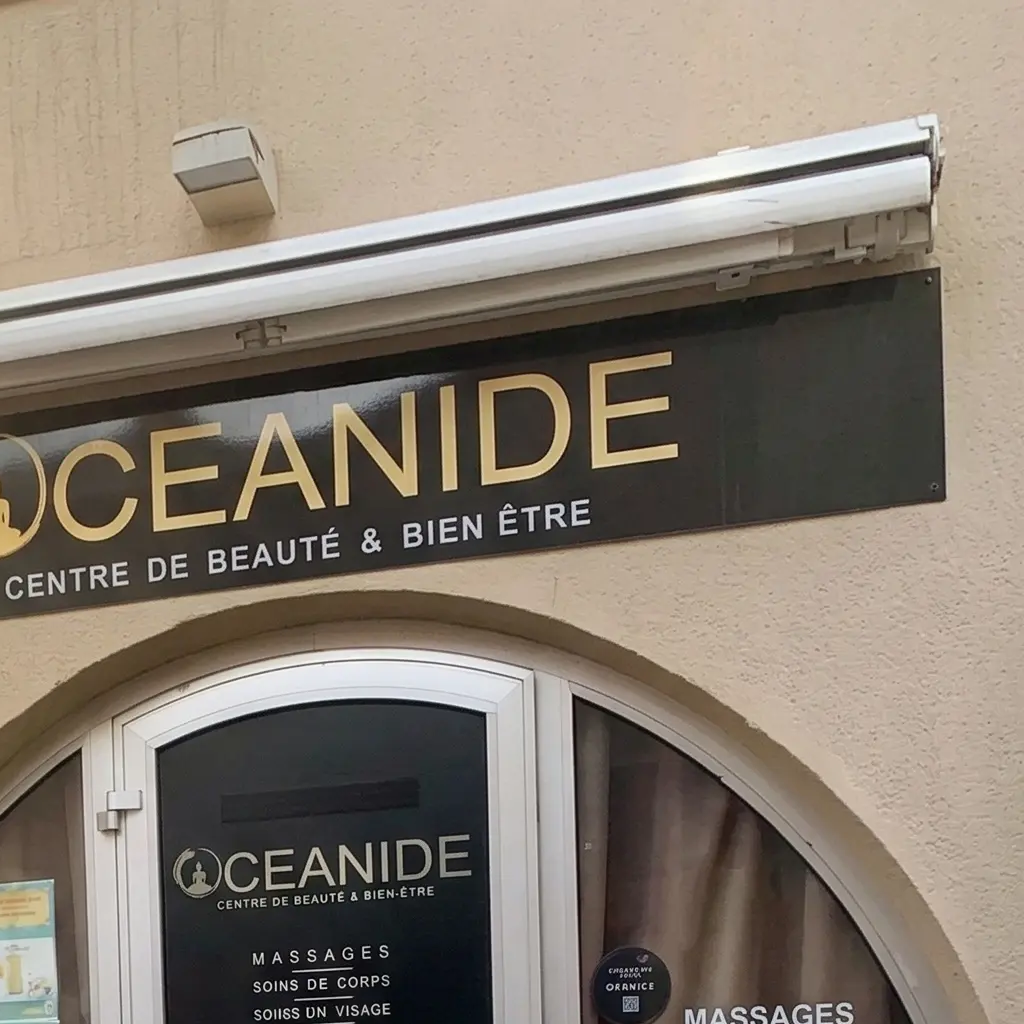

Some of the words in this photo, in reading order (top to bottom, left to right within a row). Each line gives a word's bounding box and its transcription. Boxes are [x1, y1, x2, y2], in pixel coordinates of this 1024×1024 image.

[5, 561, 129, 600] CENTRE
[148, 553, 189, 584] DE
[208, 527, 340, 576] BEAUTÉ
[361, 528, 382, 554] &
[403, 513, 483, 549] BIEN
[499, 498, 591, 537] ÊTRE
[172, 833, 472, 899] OCEANIDE
[217, 898, 267, 910] CENTRE
[273, 896, 289, 907] DE
[294, 891, 345, 905] BEAUTÉ
[351, 892, 359, 901] &
[252, 945, 389, 966] MASSAGES
[253, 979, 299, 993] SOINS
[307, 978, 328, 990] DE
[337, 974, 390, 989] CORPS
[335, 1003, 391, 1017] VISAGE
